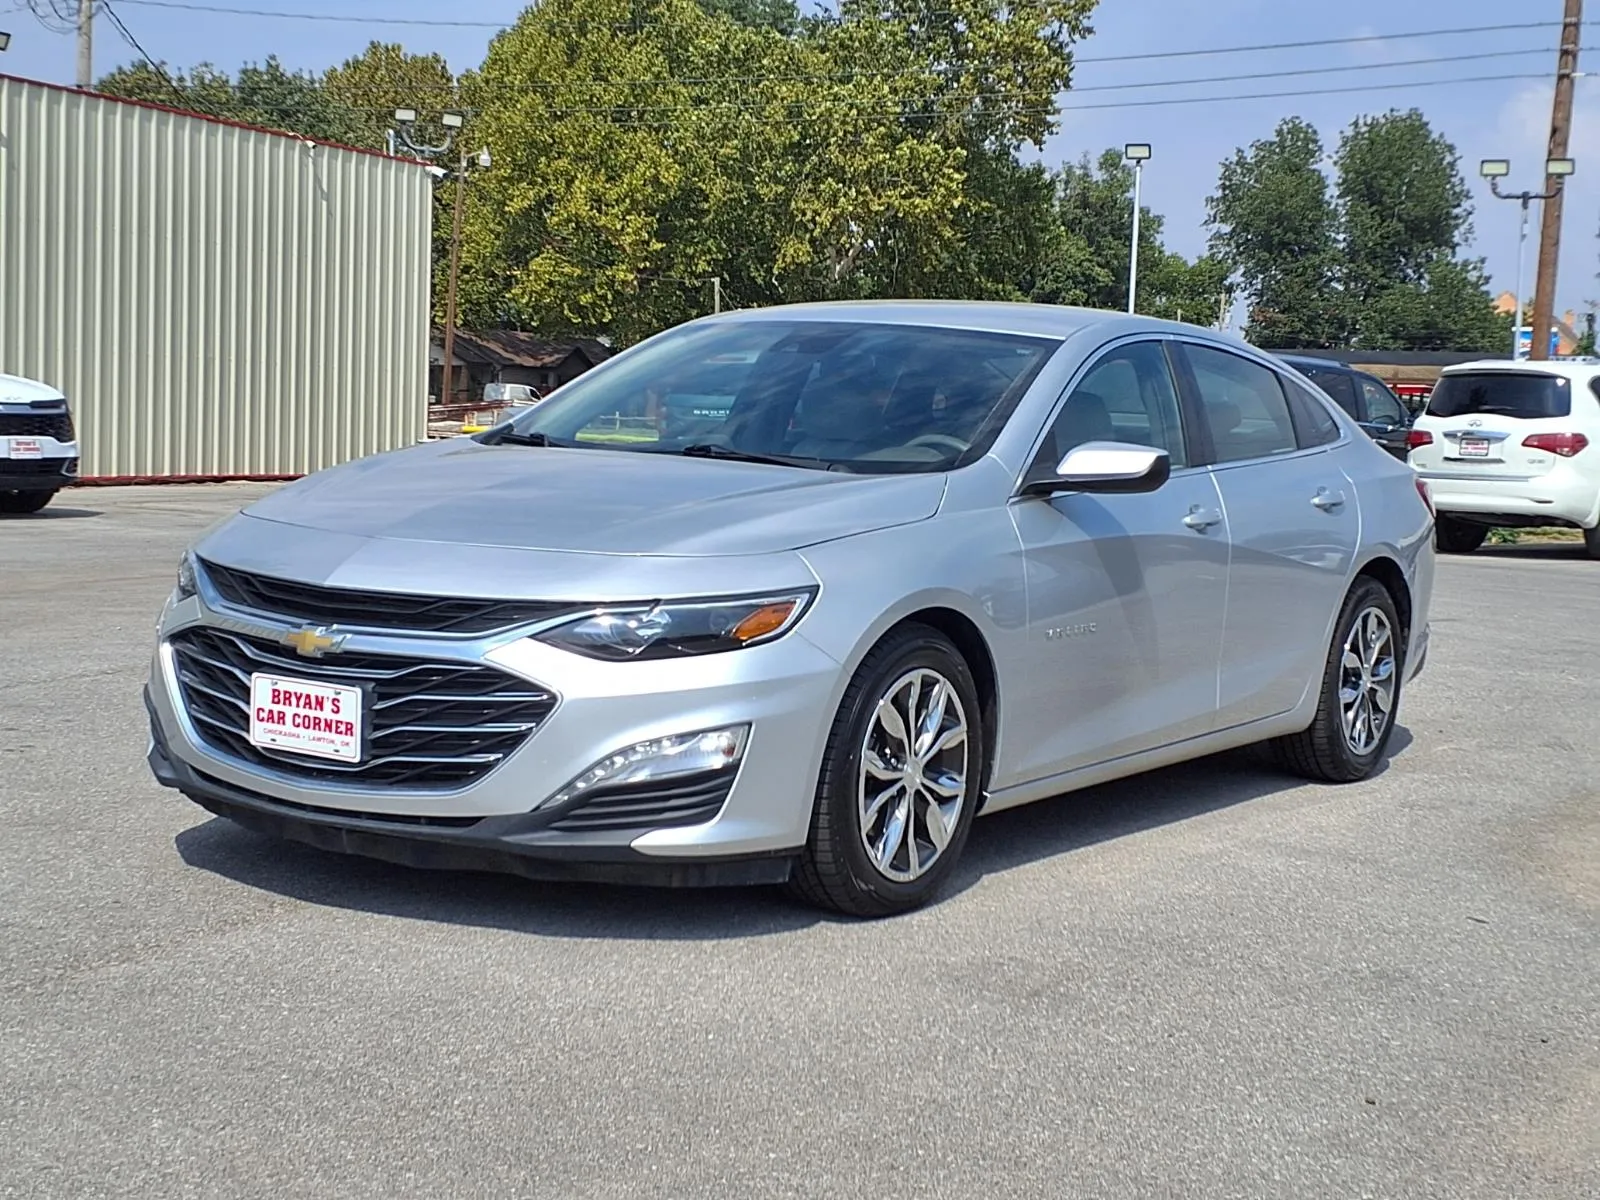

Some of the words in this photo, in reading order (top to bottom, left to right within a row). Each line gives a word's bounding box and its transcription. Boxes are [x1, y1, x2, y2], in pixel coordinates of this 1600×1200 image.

[271, 688, 341, 715] BRYAN'S
[256, 707, 286, 726] CAR
[292, 713, 354, 737] CORNER
